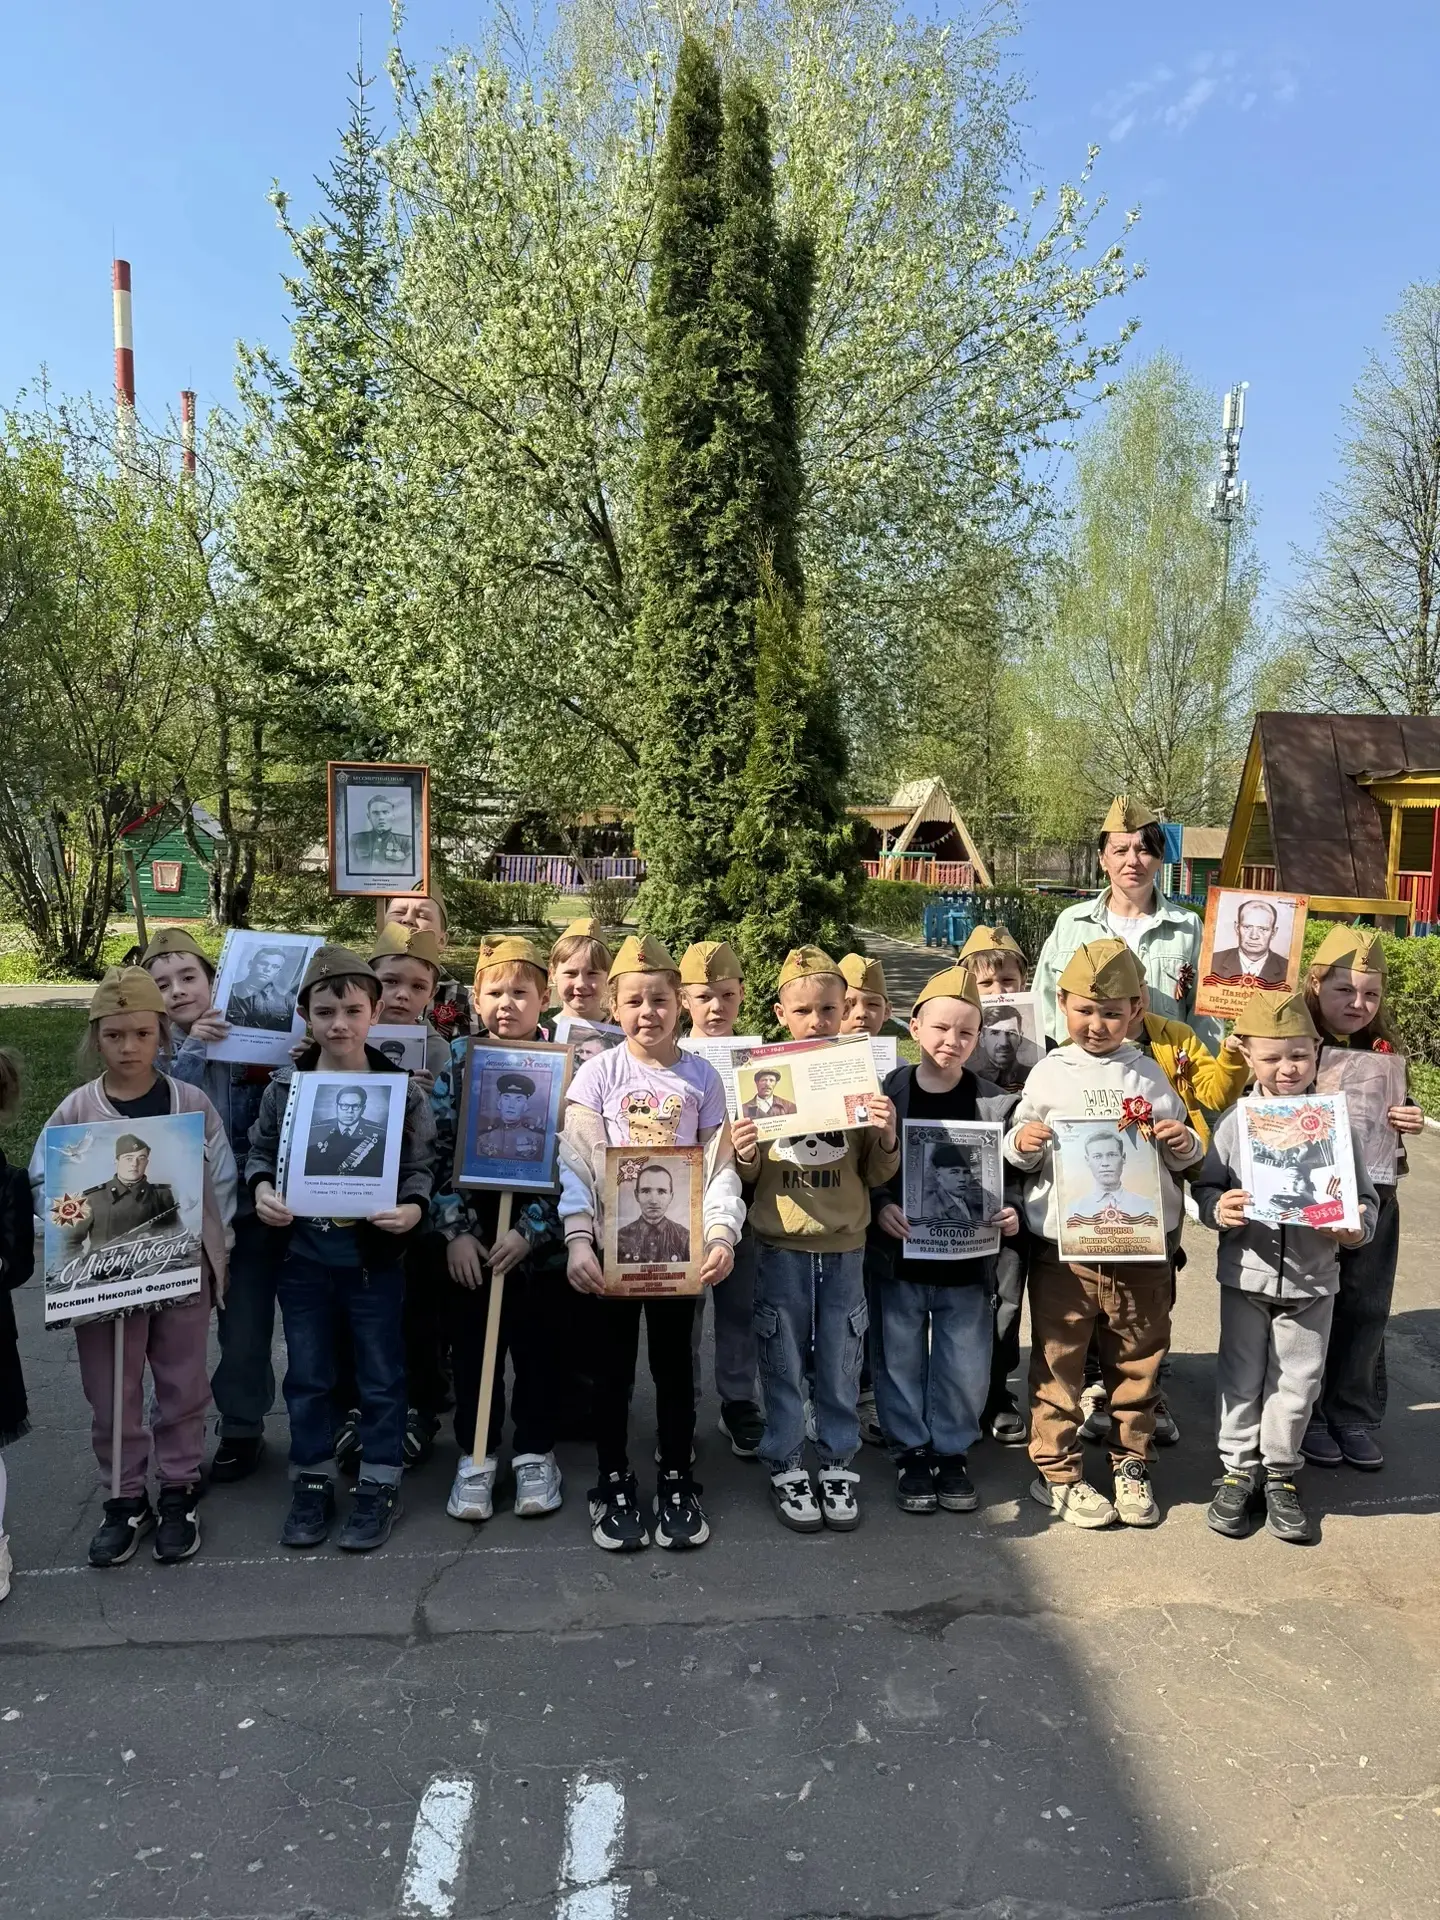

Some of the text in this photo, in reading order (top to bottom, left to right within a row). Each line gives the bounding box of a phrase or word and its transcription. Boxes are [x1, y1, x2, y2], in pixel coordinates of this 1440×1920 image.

[1083, 1088, 1124, 1108] WHAT
[782, 1169, 841, 1189] RACOON
[929, 1228, 976, 1238] СОКОЛОВ
[1093, 1226, 1135, 1236] Смирнов
[906, 1236, 995, 1247] Александр Филиппович
[1078, 1236, 1107, 1245] Никита
[60, 1227, 189, 1292] С Днём Победы
[47, 1277, 199, 1311] Москвин Николай Федотович
